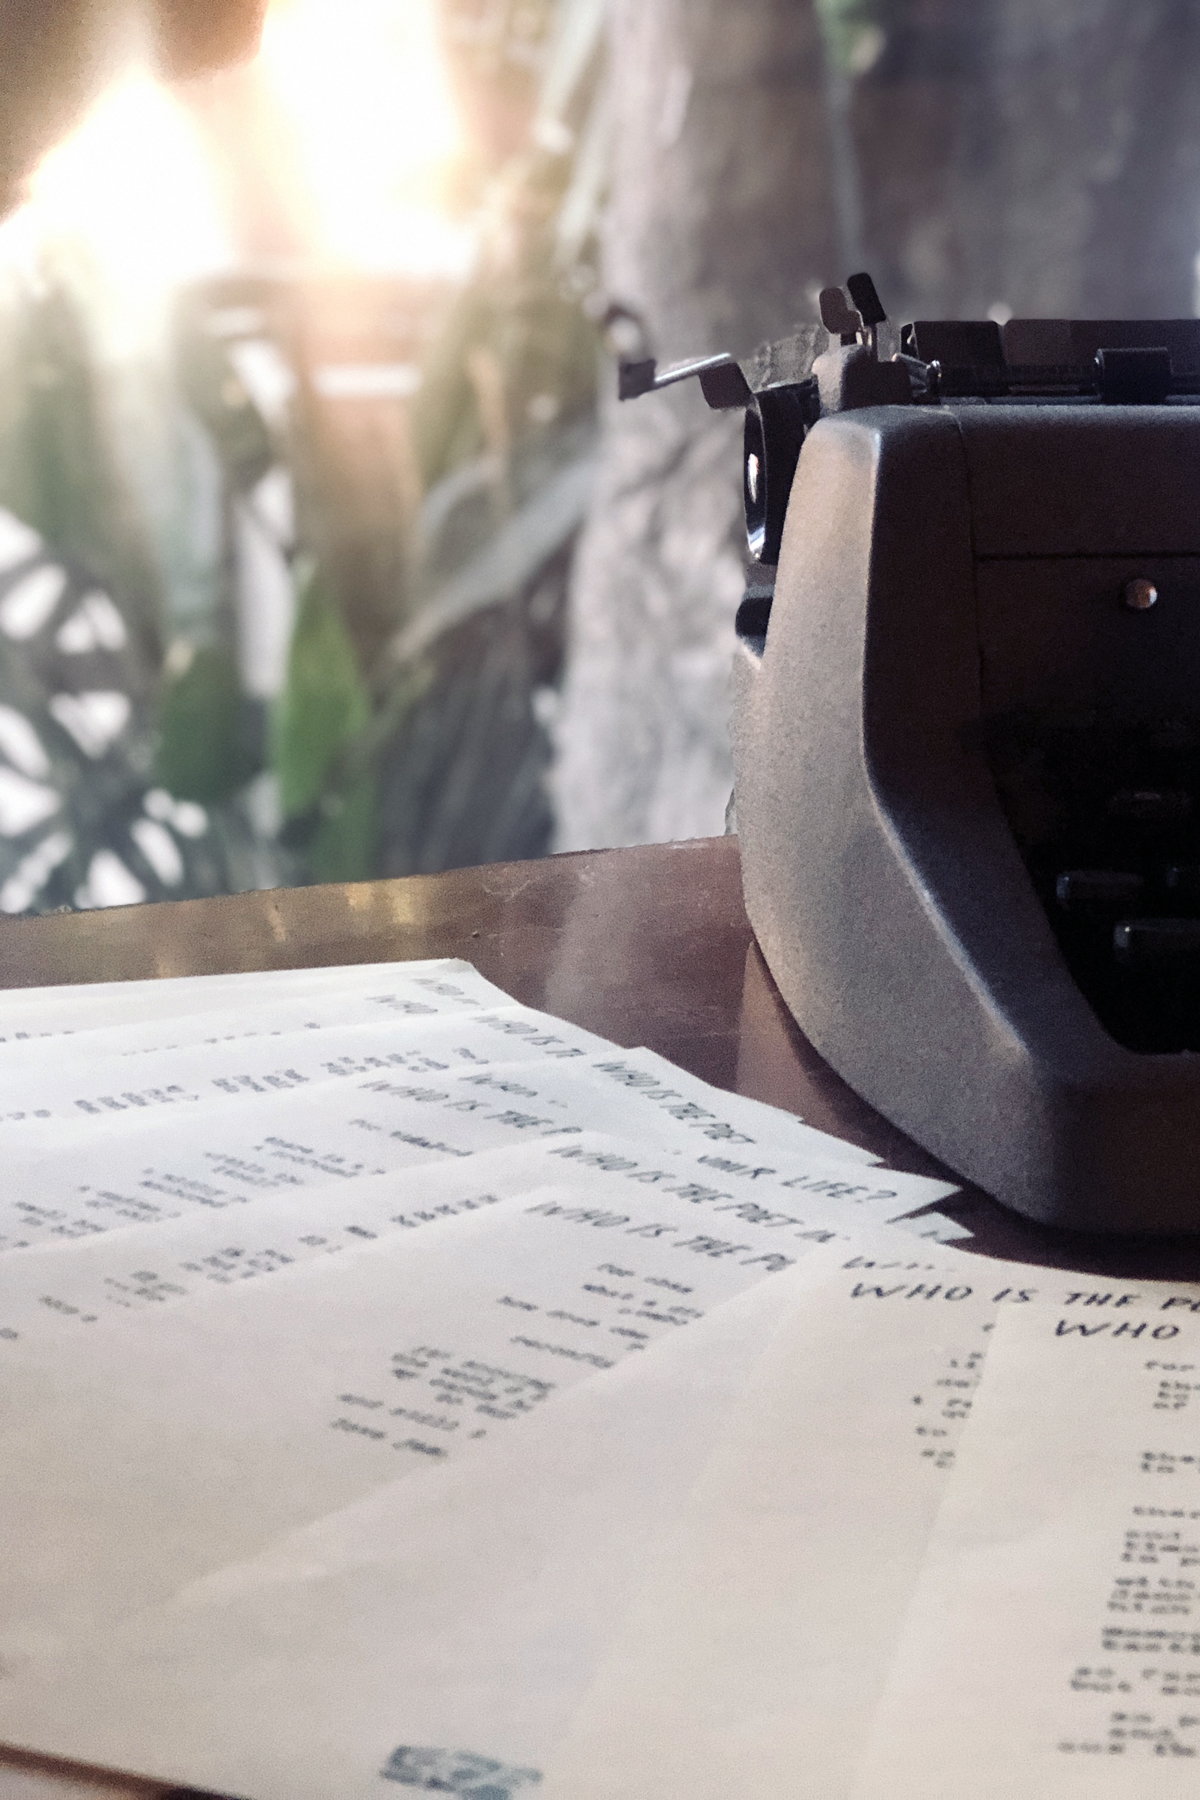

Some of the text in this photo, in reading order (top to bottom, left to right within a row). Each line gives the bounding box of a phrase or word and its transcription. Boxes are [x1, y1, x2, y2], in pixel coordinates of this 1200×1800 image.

[849, 1282, 975, 1300] WHO
[992, 1287, 1039, 1304] IS
[1063, 1290, 1141, 1308] THE
[1054, 1317, 1182, 1342] WHO
